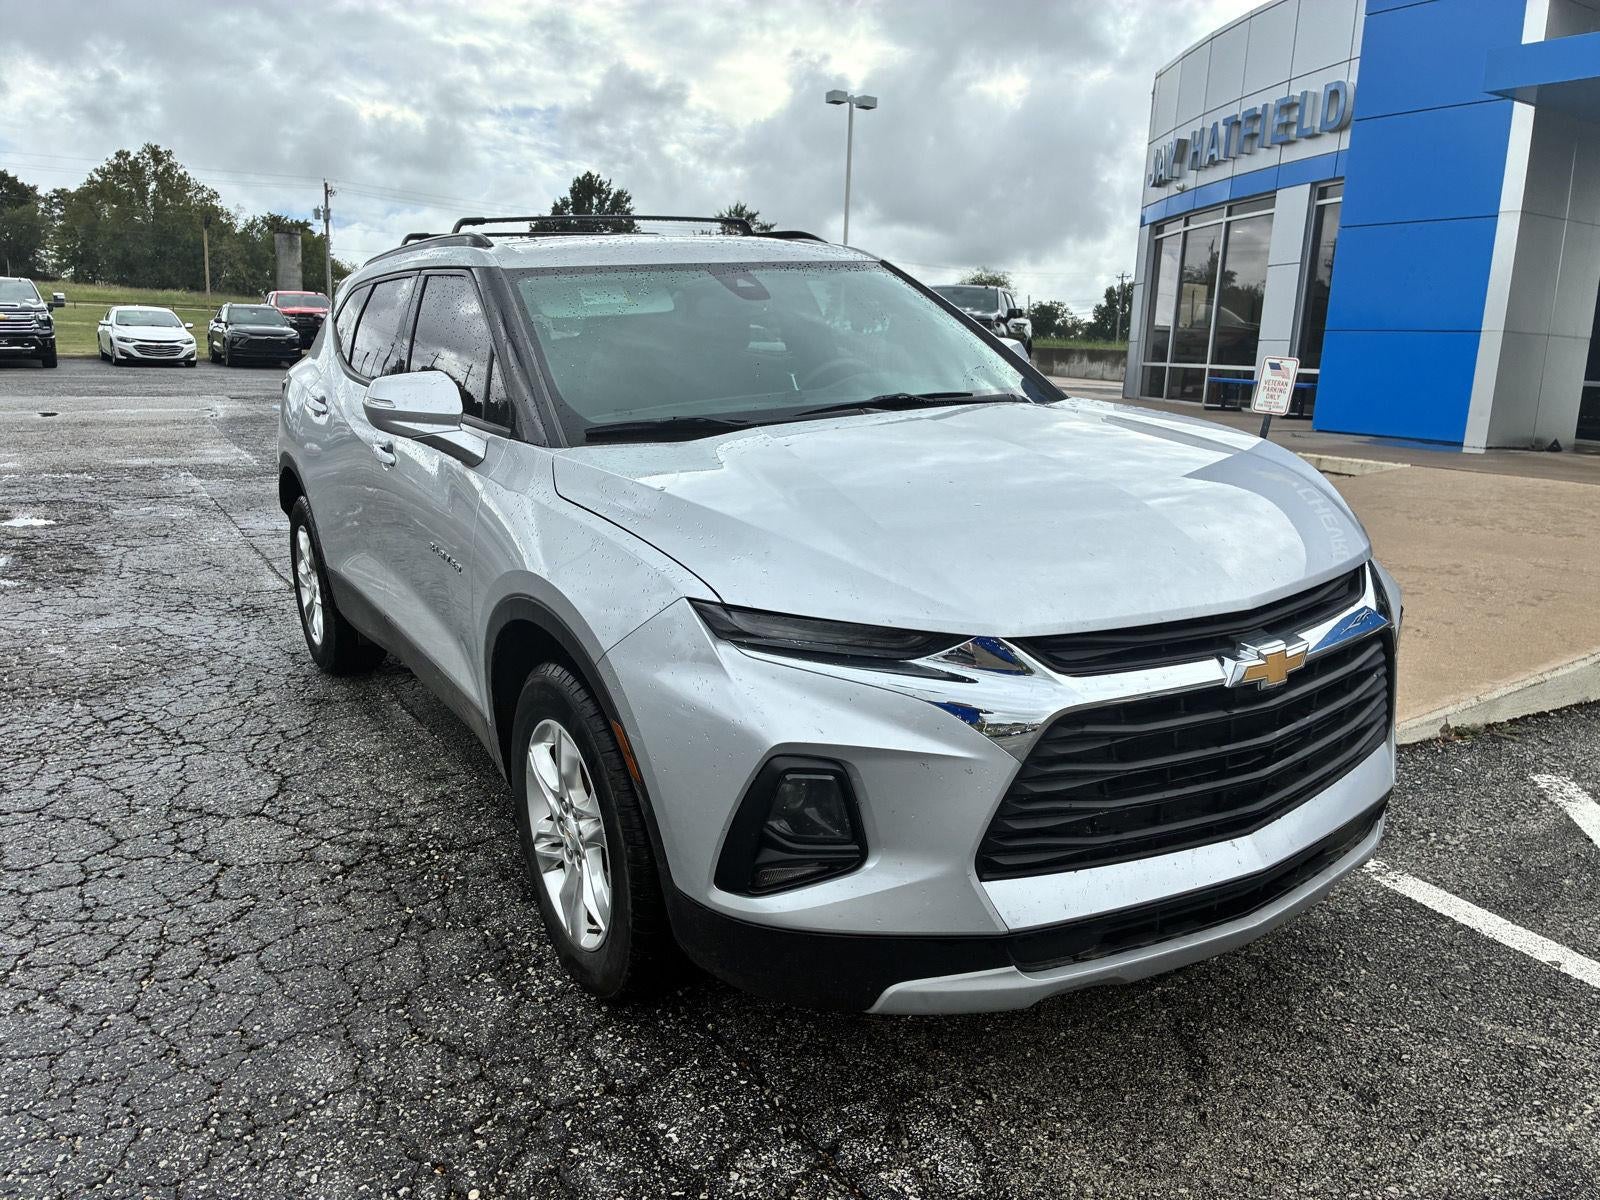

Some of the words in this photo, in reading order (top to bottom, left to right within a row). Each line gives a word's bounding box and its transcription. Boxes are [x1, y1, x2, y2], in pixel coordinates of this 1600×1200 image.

[1148, 138, 1186, 187] JAY
[1188, 80, 1355, 170] HATFIELD
[1264, 379, 1288, 387] VETERAN
[1263, 386, 1287, 394] PARKING
